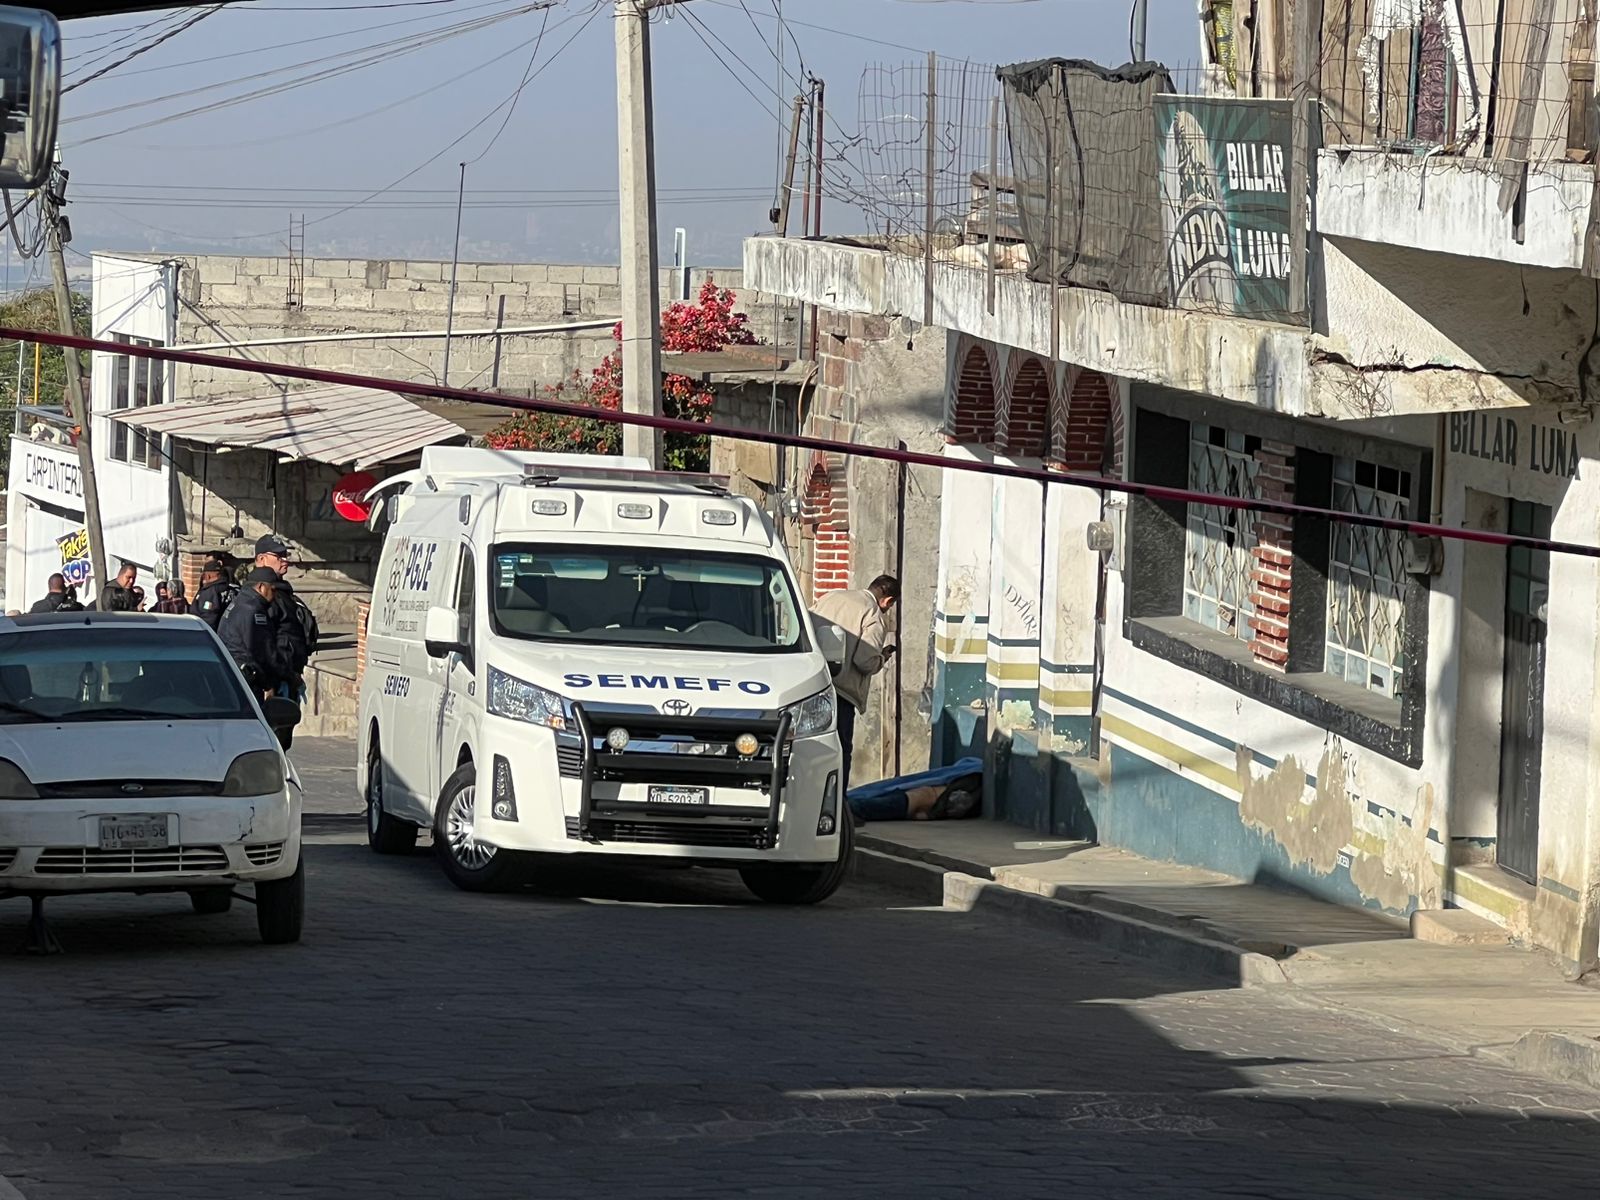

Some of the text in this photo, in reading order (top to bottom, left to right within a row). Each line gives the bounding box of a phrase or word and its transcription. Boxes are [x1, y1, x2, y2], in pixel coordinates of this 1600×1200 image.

[1226, 142, 1287, 193] BILLAR
[1450, 411, 1581, 480] BILLAR LUNA
[26, 453, 83, 498] CARPINTERI
[62, 559, 92, 584] POP
[402, 542, 437, 591] PGJE
[384, 674, 410, 697] SEMEFO
[563, 673, 771, 695] SEMEFO
